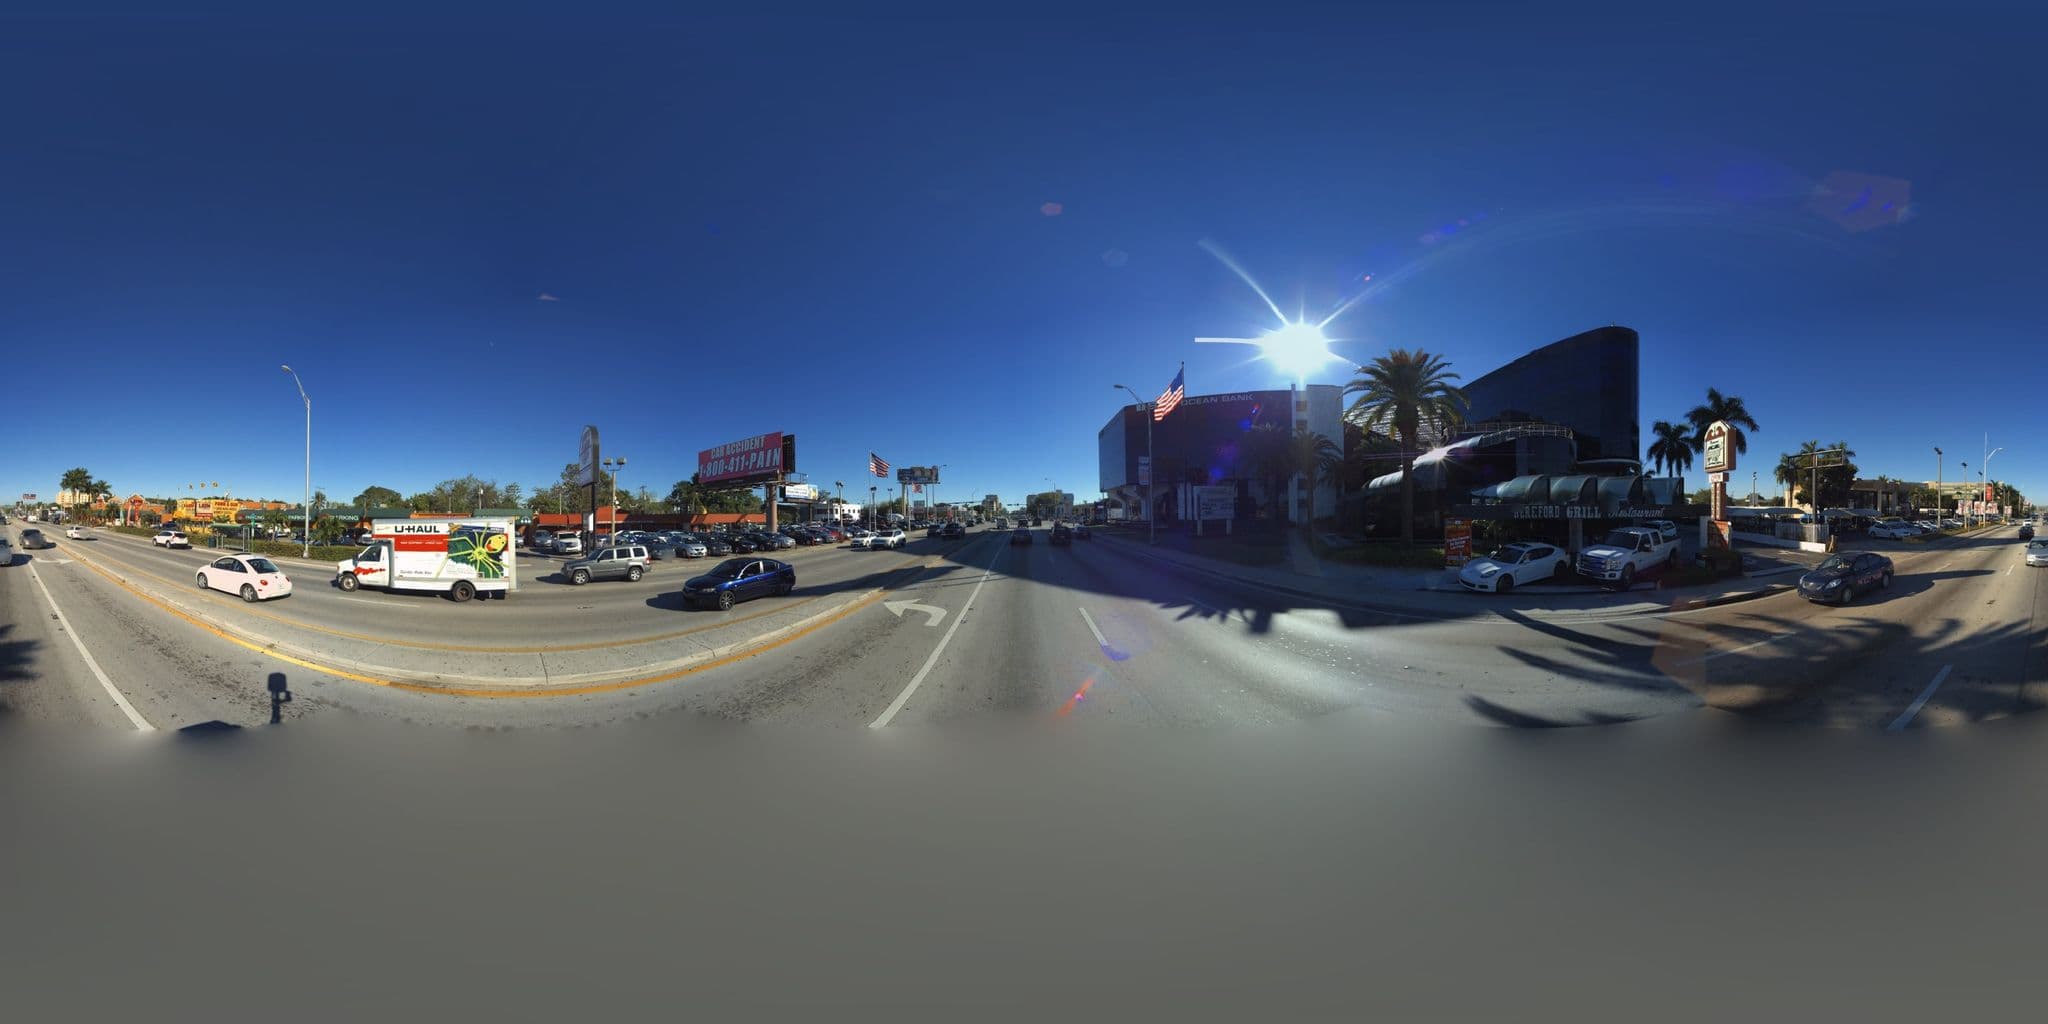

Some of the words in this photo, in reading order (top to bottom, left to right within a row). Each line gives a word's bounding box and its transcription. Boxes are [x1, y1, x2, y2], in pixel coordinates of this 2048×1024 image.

[1181, 397, 1218, 406] OCEAN
[711, 446, 725, 459] CAR
[726, 436, 765, 456] ACCIDENT
[700, 447, 781, 478] 1-800-411-PAIN
[1566, 506, 1601, 519] GRILL
[394, 525, 440, 533] U-HAUL
